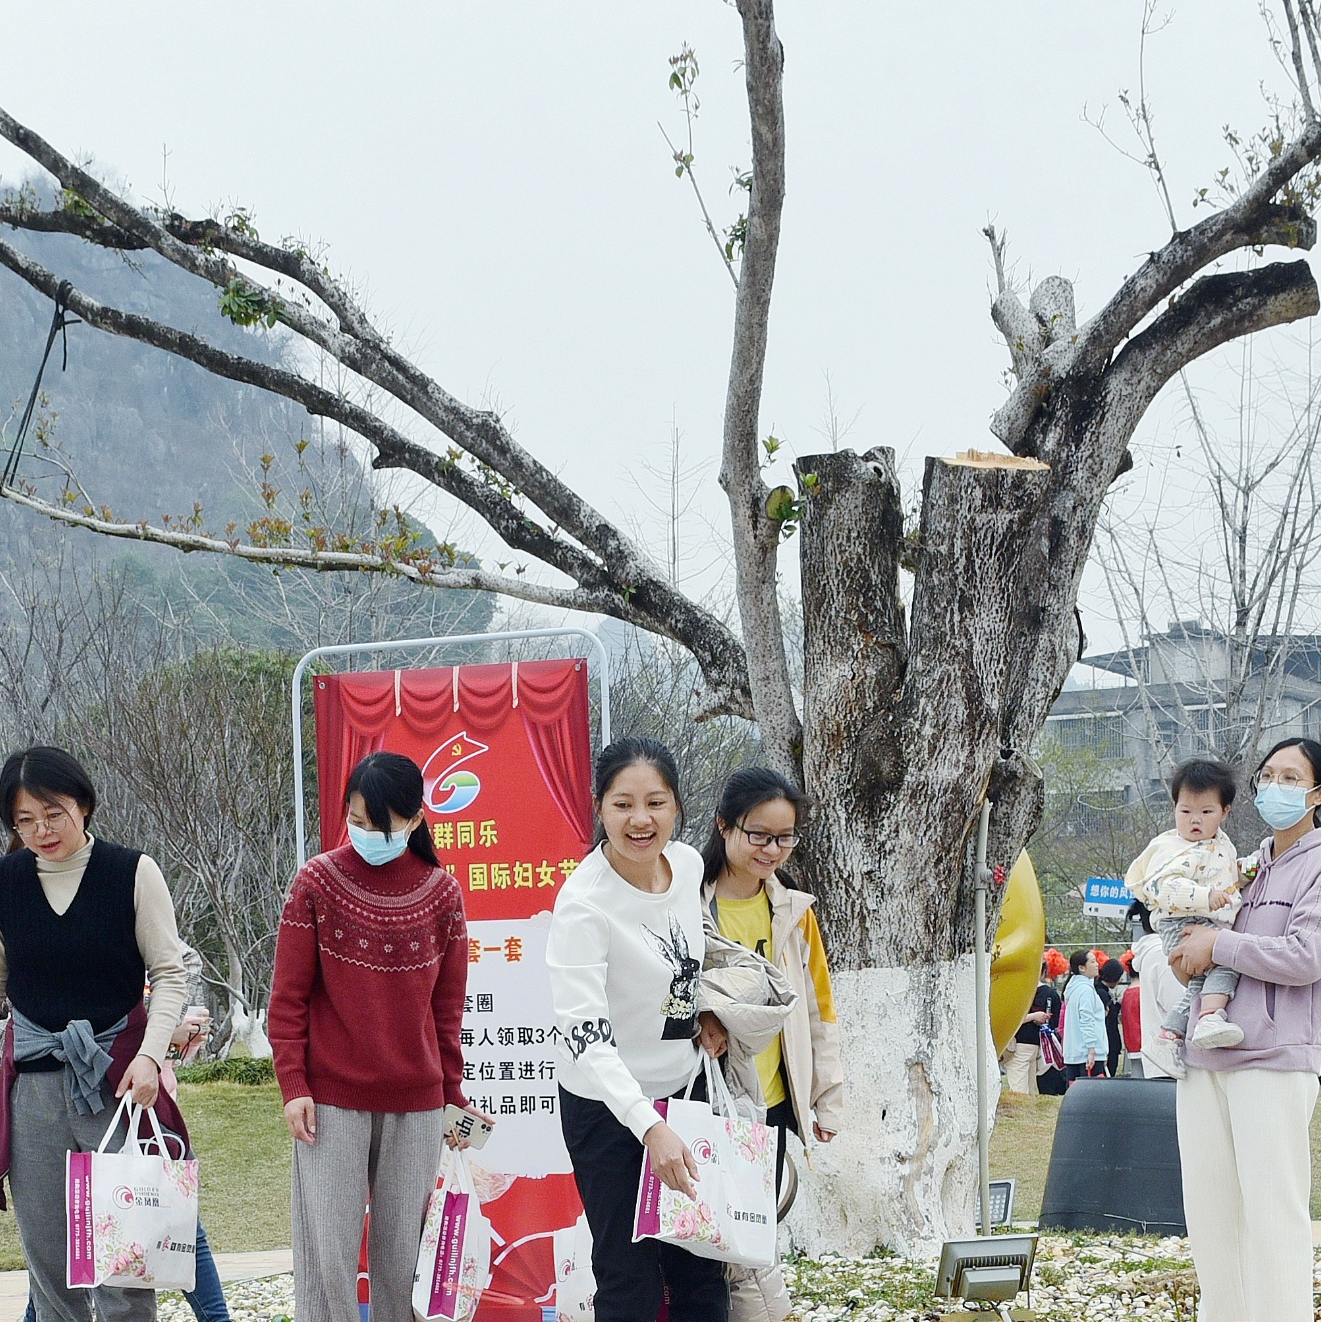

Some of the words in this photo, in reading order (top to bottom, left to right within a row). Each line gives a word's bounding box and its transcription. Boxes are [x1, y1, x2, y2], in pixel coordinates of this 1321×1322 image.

[429, 820, 498, 849] 群同乐
[1090, 884, 1134, 899] 想你的风
[459, 1025, 563, 1046] 每人领取3个
[462, 1060, 556, 1081] 定位置进行
